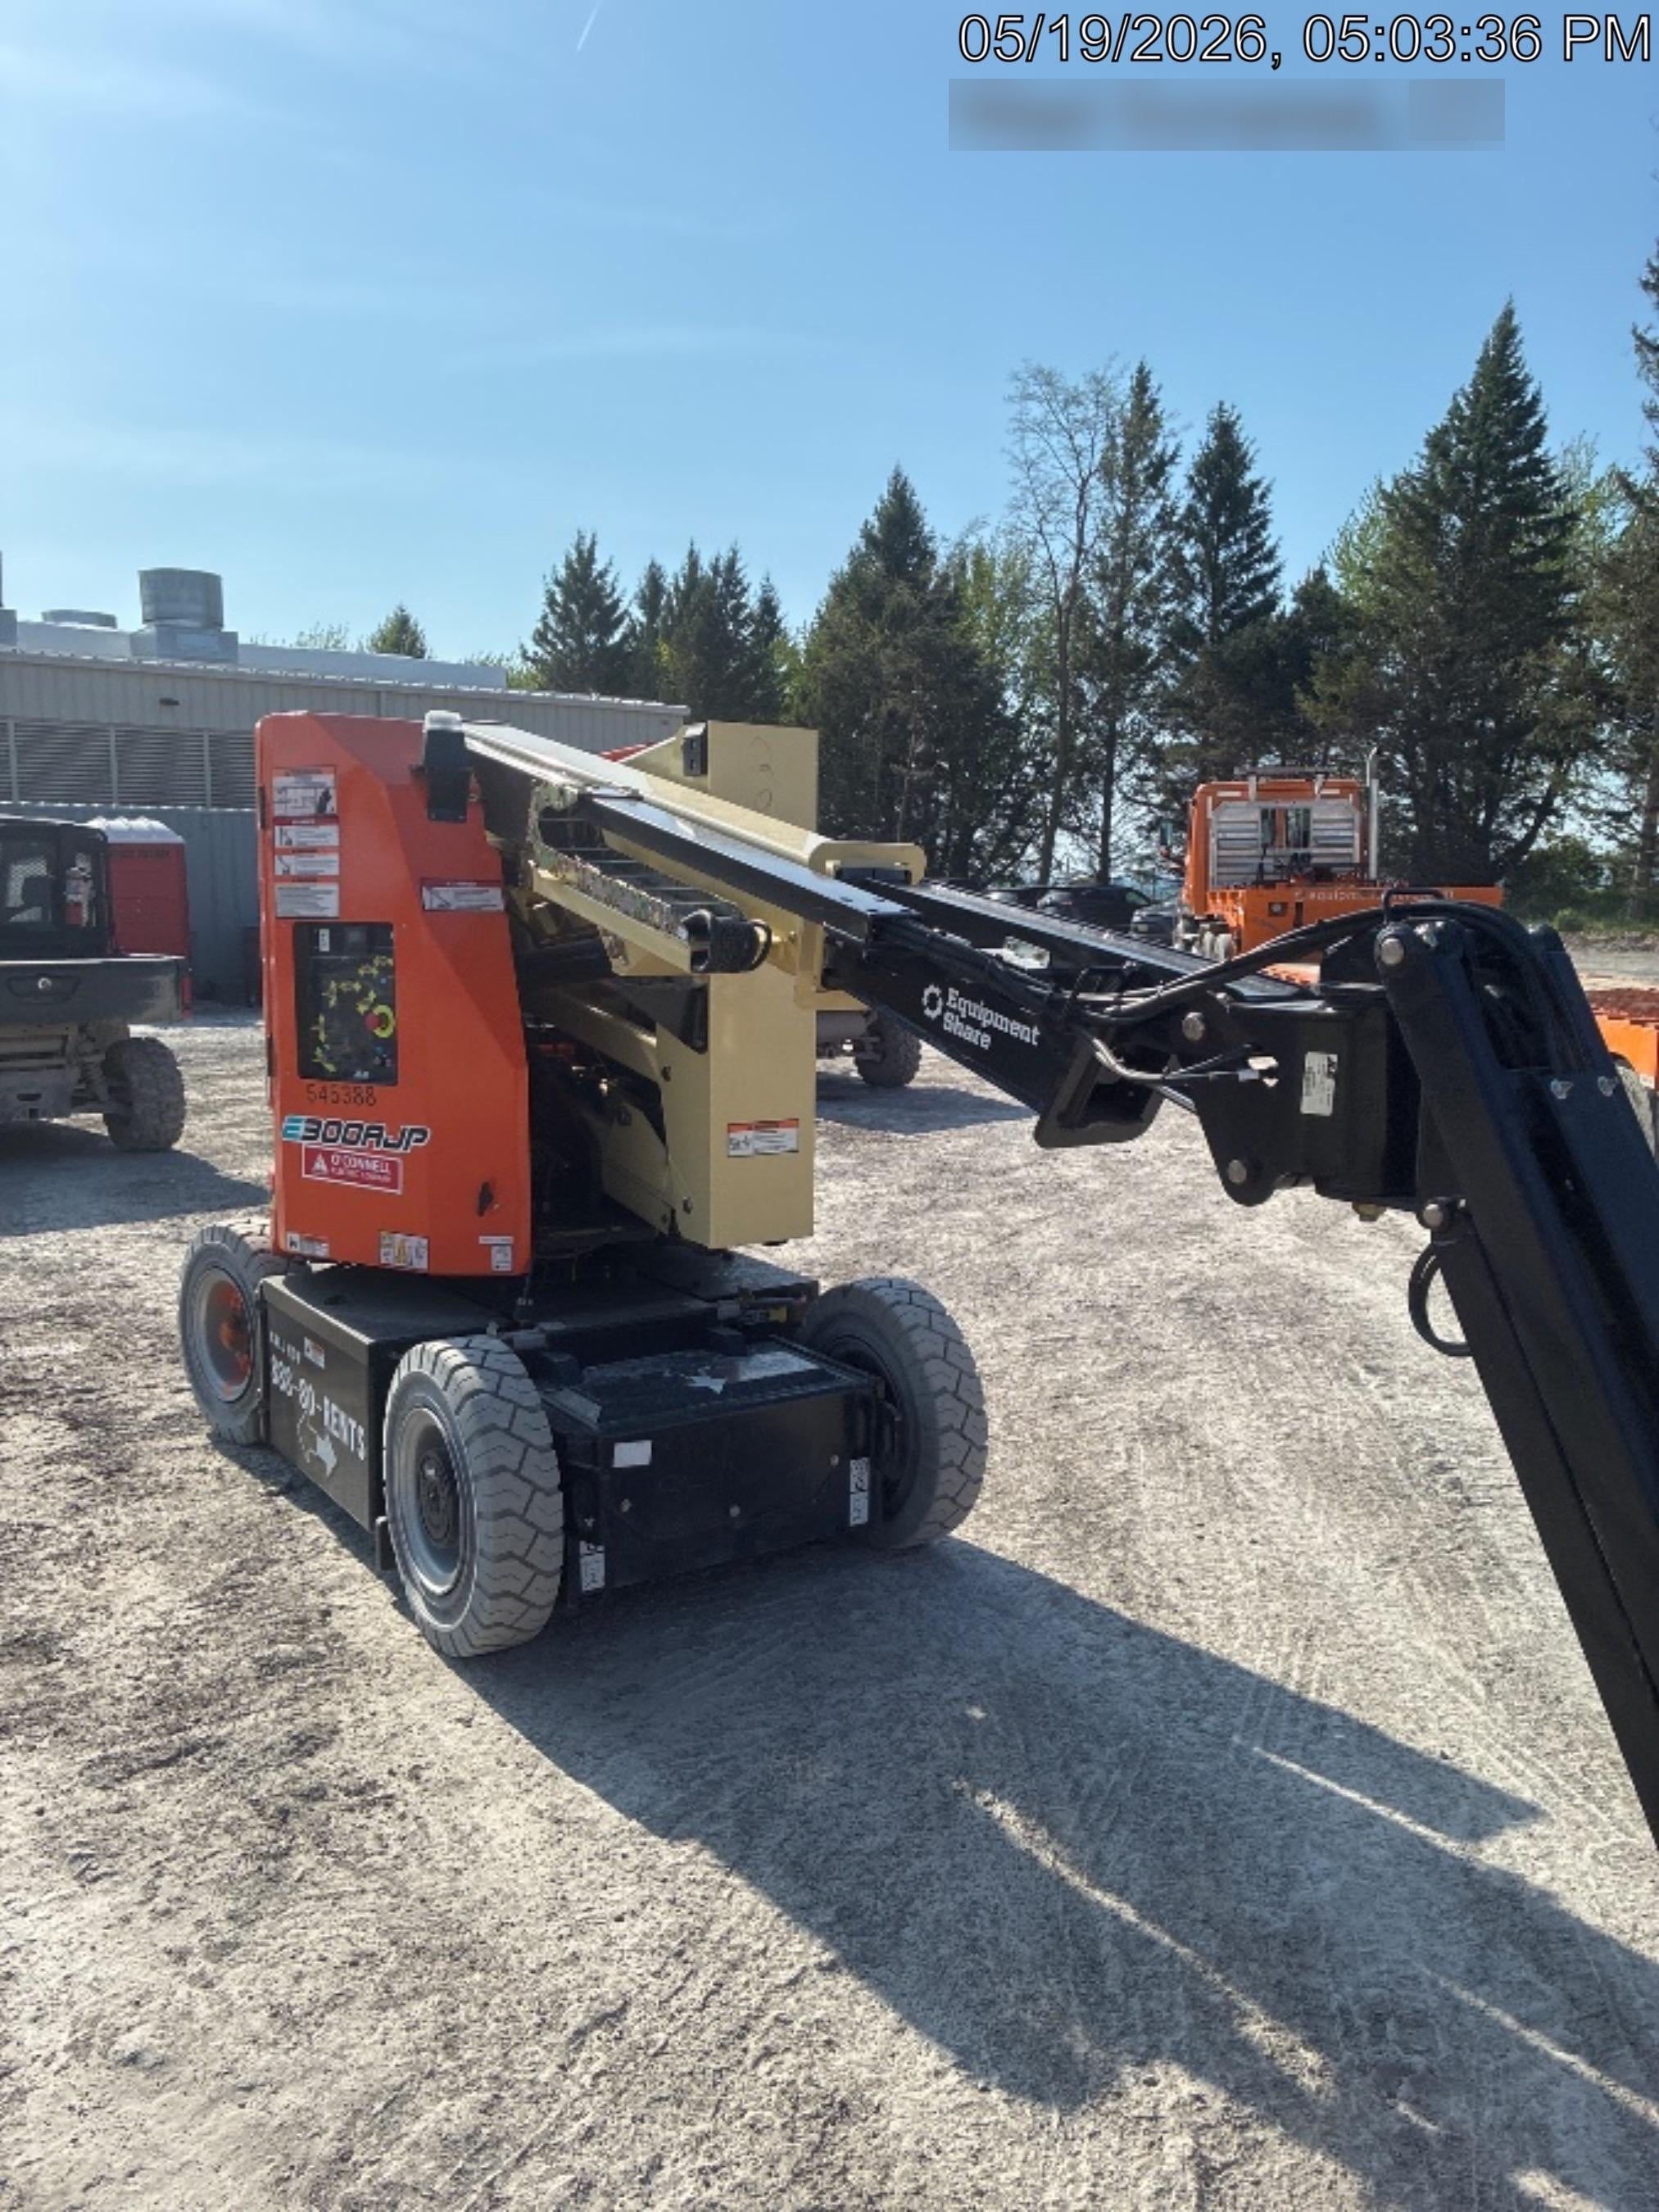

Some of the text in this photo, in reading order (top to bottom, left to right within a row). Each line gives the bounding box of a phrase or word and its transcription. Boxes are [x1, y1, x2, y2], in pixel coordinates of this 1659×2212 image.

[944, 1011, 991, 1049] Share
[946, 987, 1040, 1045] Equipment
[282, 1116, 429, 1152] E300AJP
